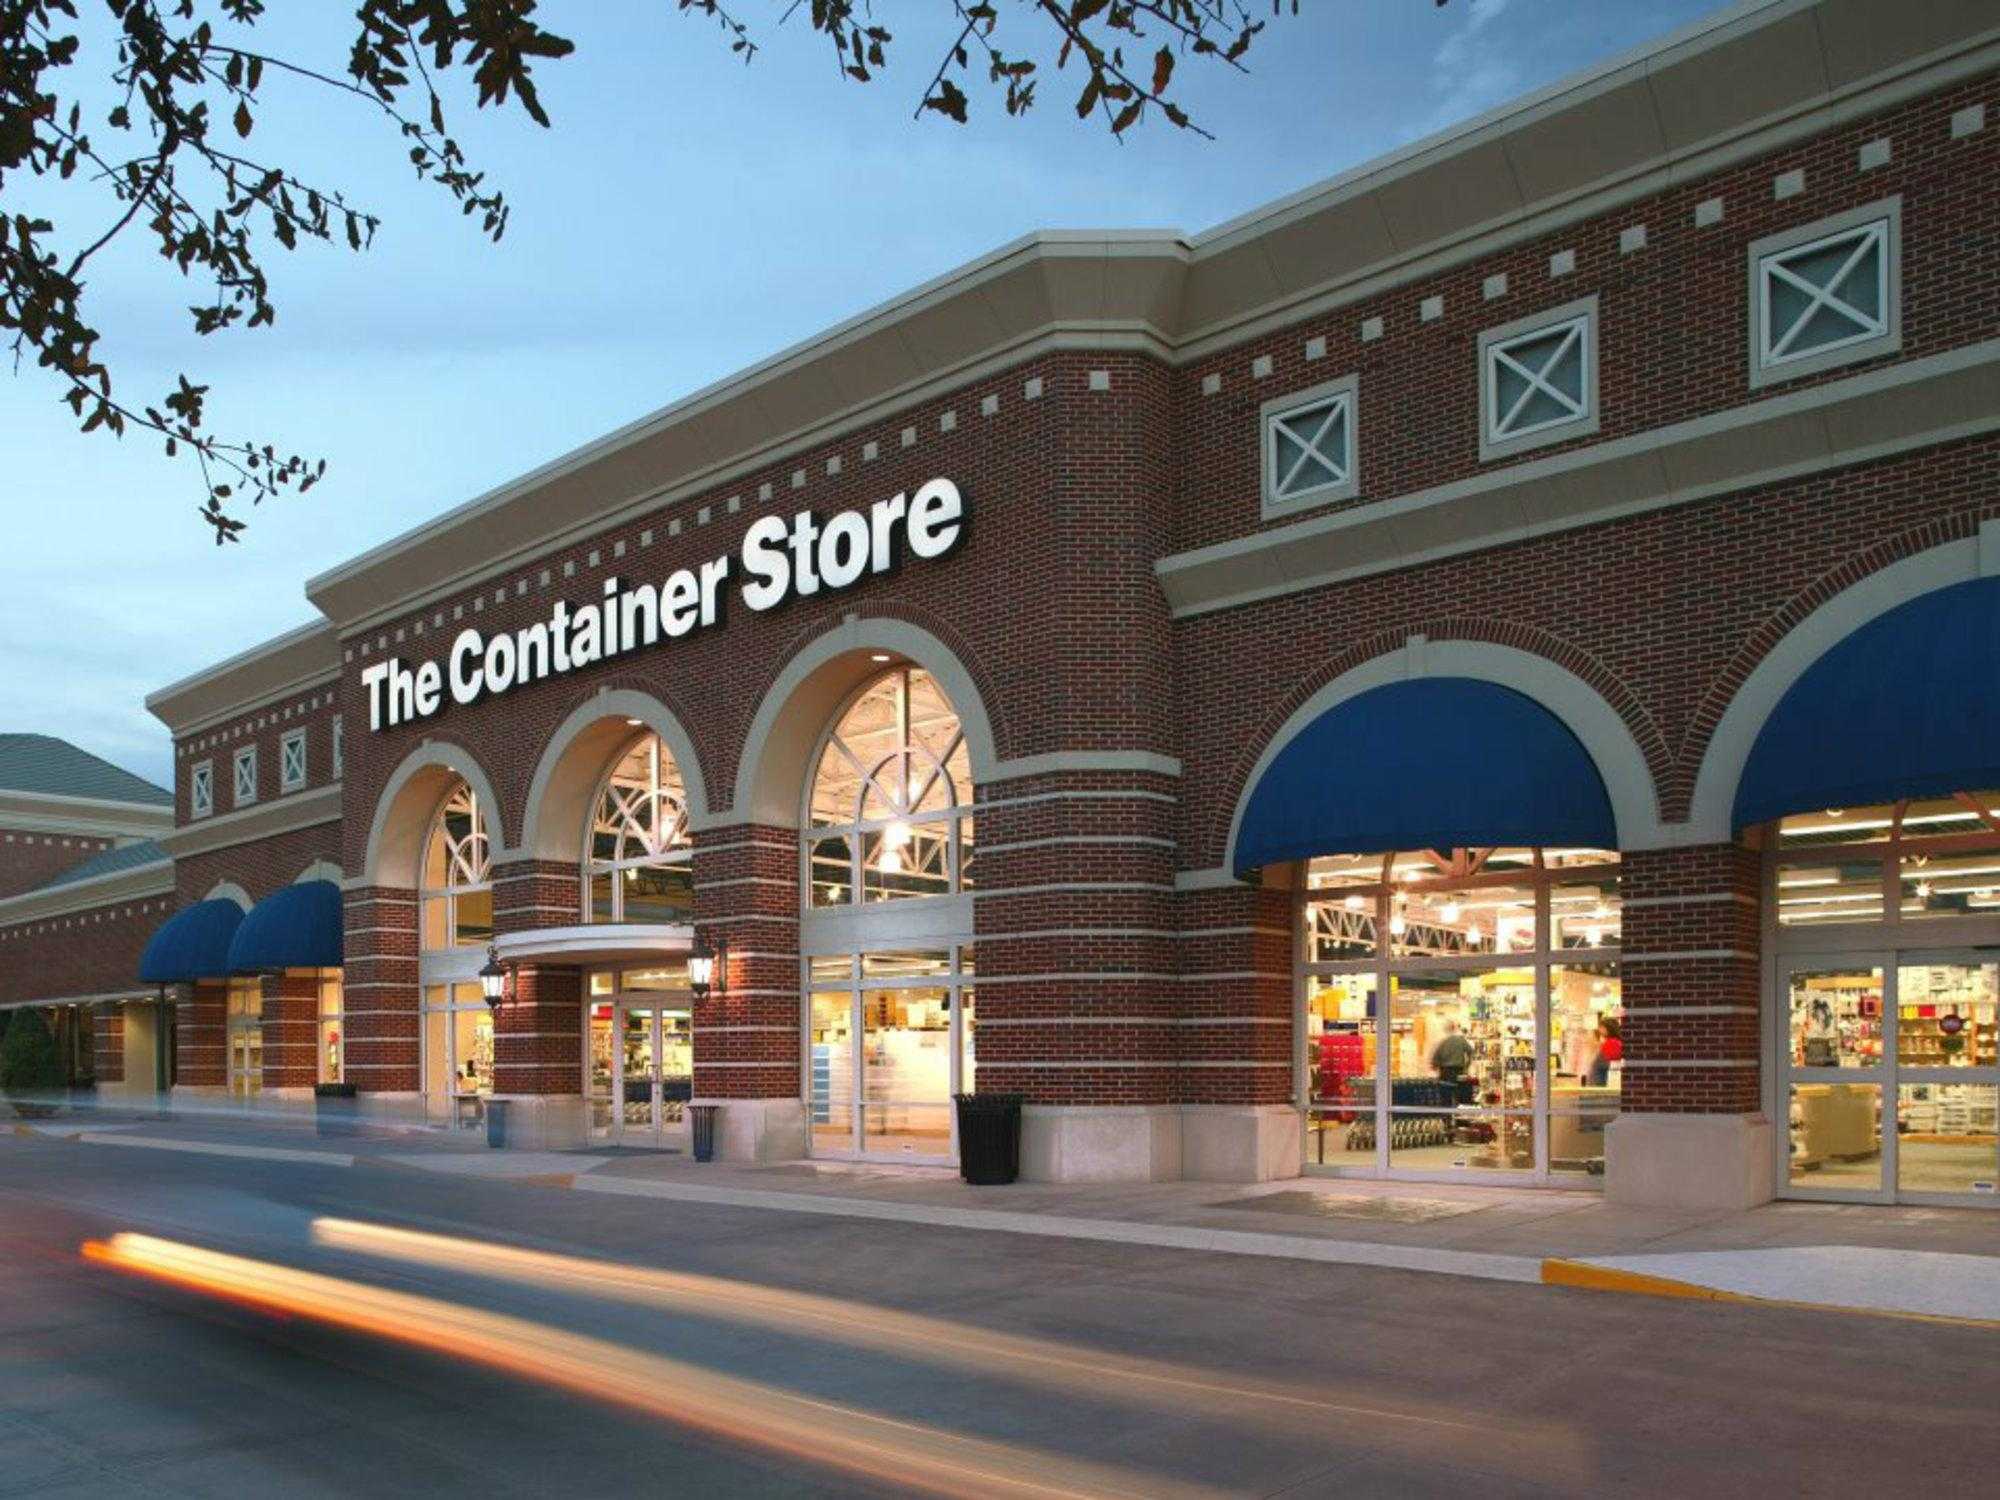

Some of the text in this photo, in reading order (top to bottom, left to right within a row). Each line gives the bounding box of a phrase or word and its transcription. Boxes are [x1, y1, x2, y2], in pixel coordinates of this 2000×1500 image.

[361, 477, 962, 732] The Container Store
